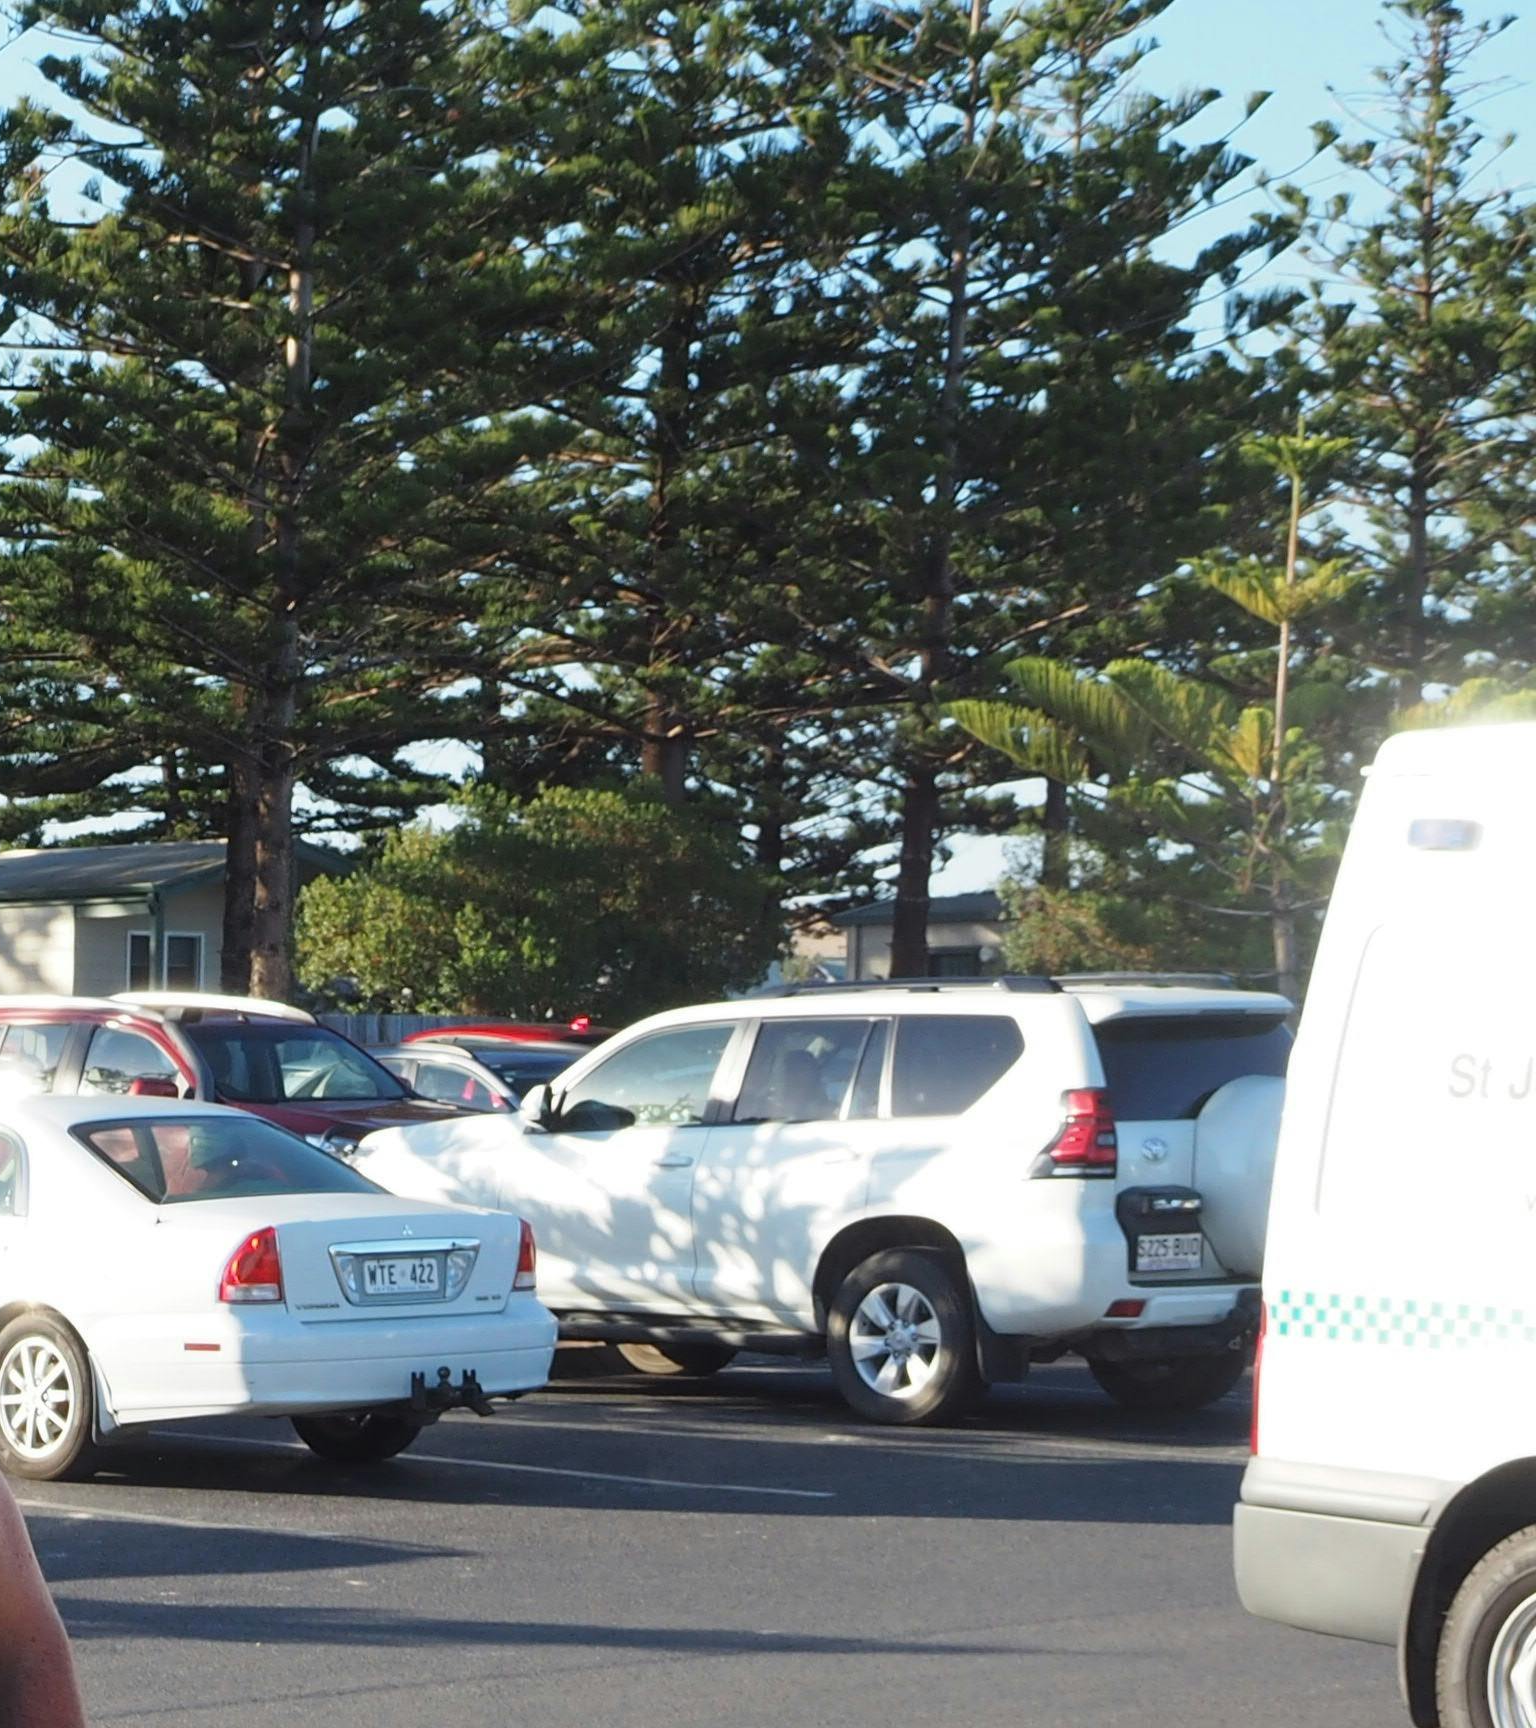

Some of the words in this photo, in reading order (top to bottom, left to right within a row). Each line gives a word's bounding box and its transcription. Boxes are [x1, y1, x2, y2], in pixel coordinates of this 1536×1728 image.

[1448, 1052, 1493, 1099] St
[367, 1264, 397, 1286] WTE
[409, 1263, 435, 1284] 422
